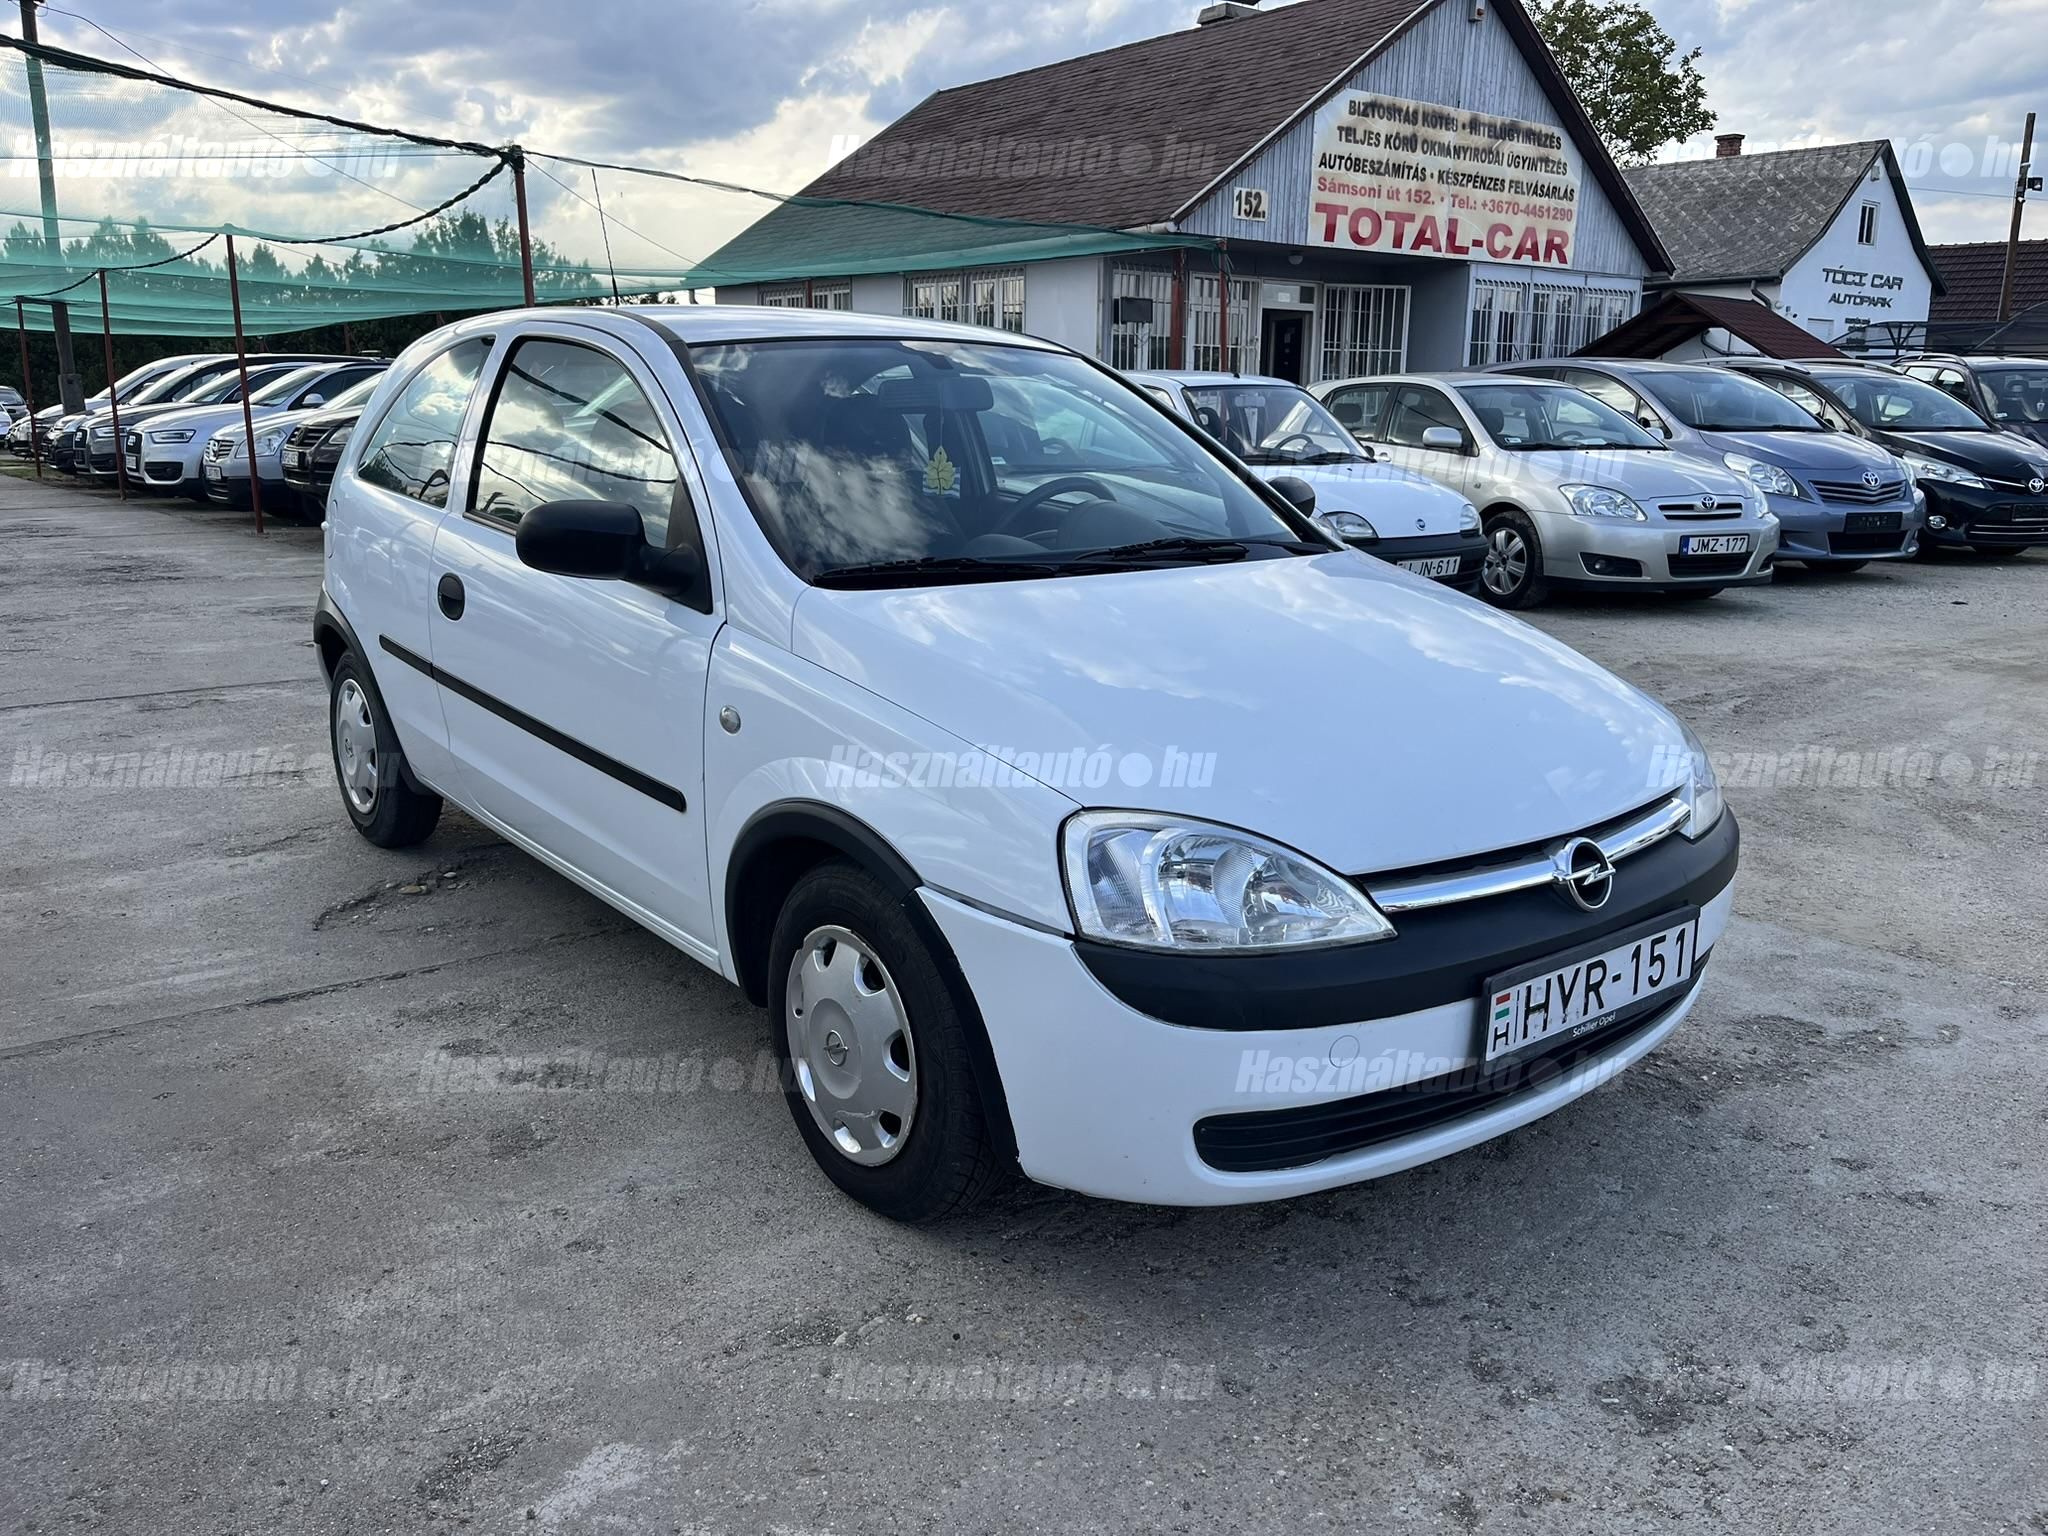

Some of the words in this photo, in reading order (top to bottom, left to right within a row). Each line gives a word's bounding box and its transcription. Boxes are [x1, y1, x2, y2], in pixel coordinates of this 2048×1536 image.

[1337, 126, 1381, 148] TELJES
[1421, 138, 1504, 167] OKMÁNYIRODAI
[1507, 152, 1568, 176] ÜGYINTÉZÉS
[1318, 152, 1427, 182] AUTÓBESZÁMÍTÁS
[1437, 168, 1505, 193] KÉSZPÉNZES
[1508, 178, 1575, 202] FELVÁSÁRLÁS
[1235, 189, 1266, 218] 152.
[1318, 176, 1382, 199] Sámsoni
[1387, 185, 1401, 201] út
[1406, 188, 1435, 205] 152.
[1450, 193, 1477, 211] Tel.:
[1481, 199, 1574, 222] +3670-4451290
[1315, 202, 1568, 265] TOTAL-CAR
[1828, 291, 1893, 308] AUTÓPARK
[1870, 274, 1904, 291] CAR
[1691, 537, 1746, 553] JMZ-177
[1522, 928, 1686, 1040] HYR-151
[1599, 1011, 1616, 1026] Opel
